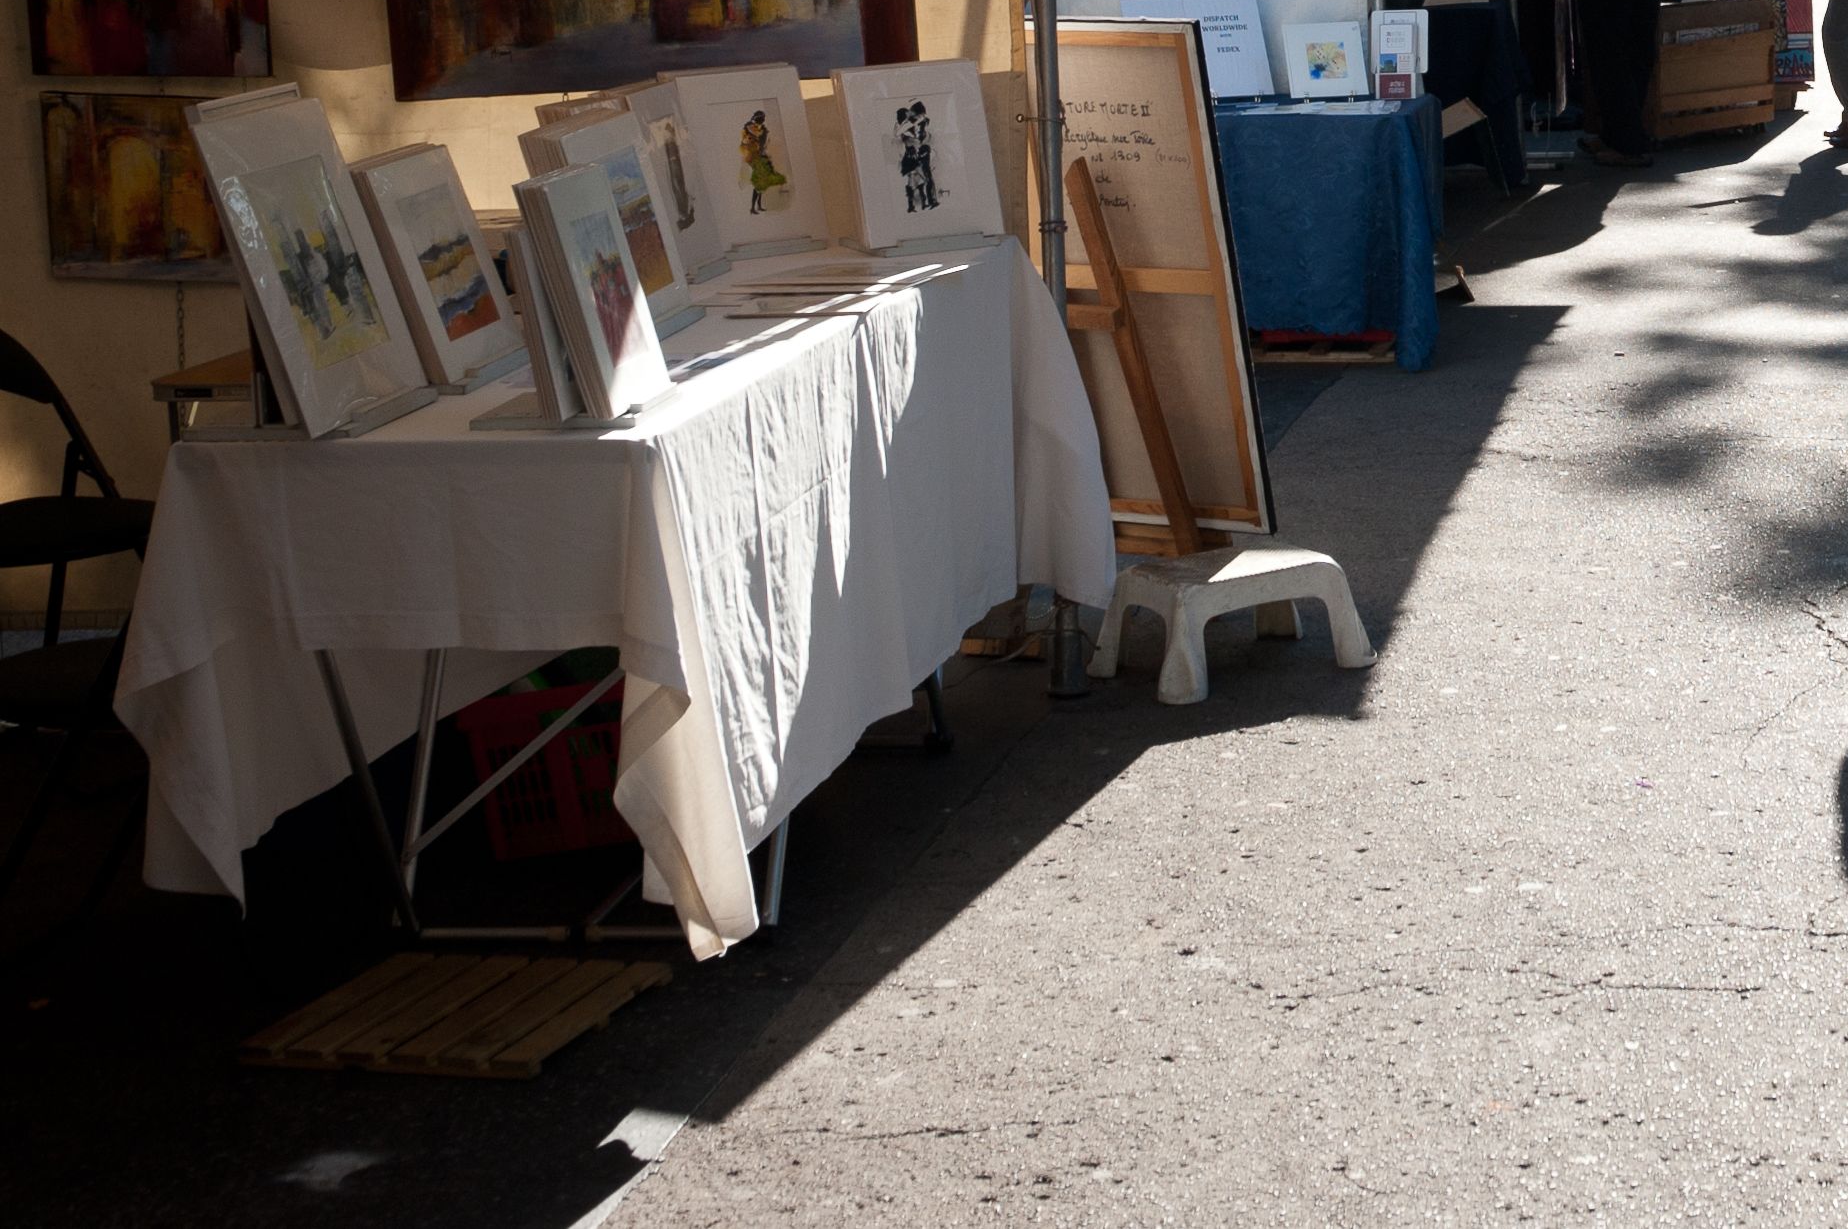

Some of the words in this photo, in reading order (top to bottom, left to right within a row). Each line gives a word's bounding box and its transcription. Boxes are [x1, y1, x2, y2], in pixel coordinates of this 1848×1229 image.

[1203, 14, 1239, 22] DISPATCH
[1201, 23, 1248, 32] WORLDWIDE
[1216, 45, 1240, 53] FEDEX
[1065, 101, 1096, 114] TURE
[1099, 102, 1139, 118] MORTE
[1094, 170, 1112, 184] de
